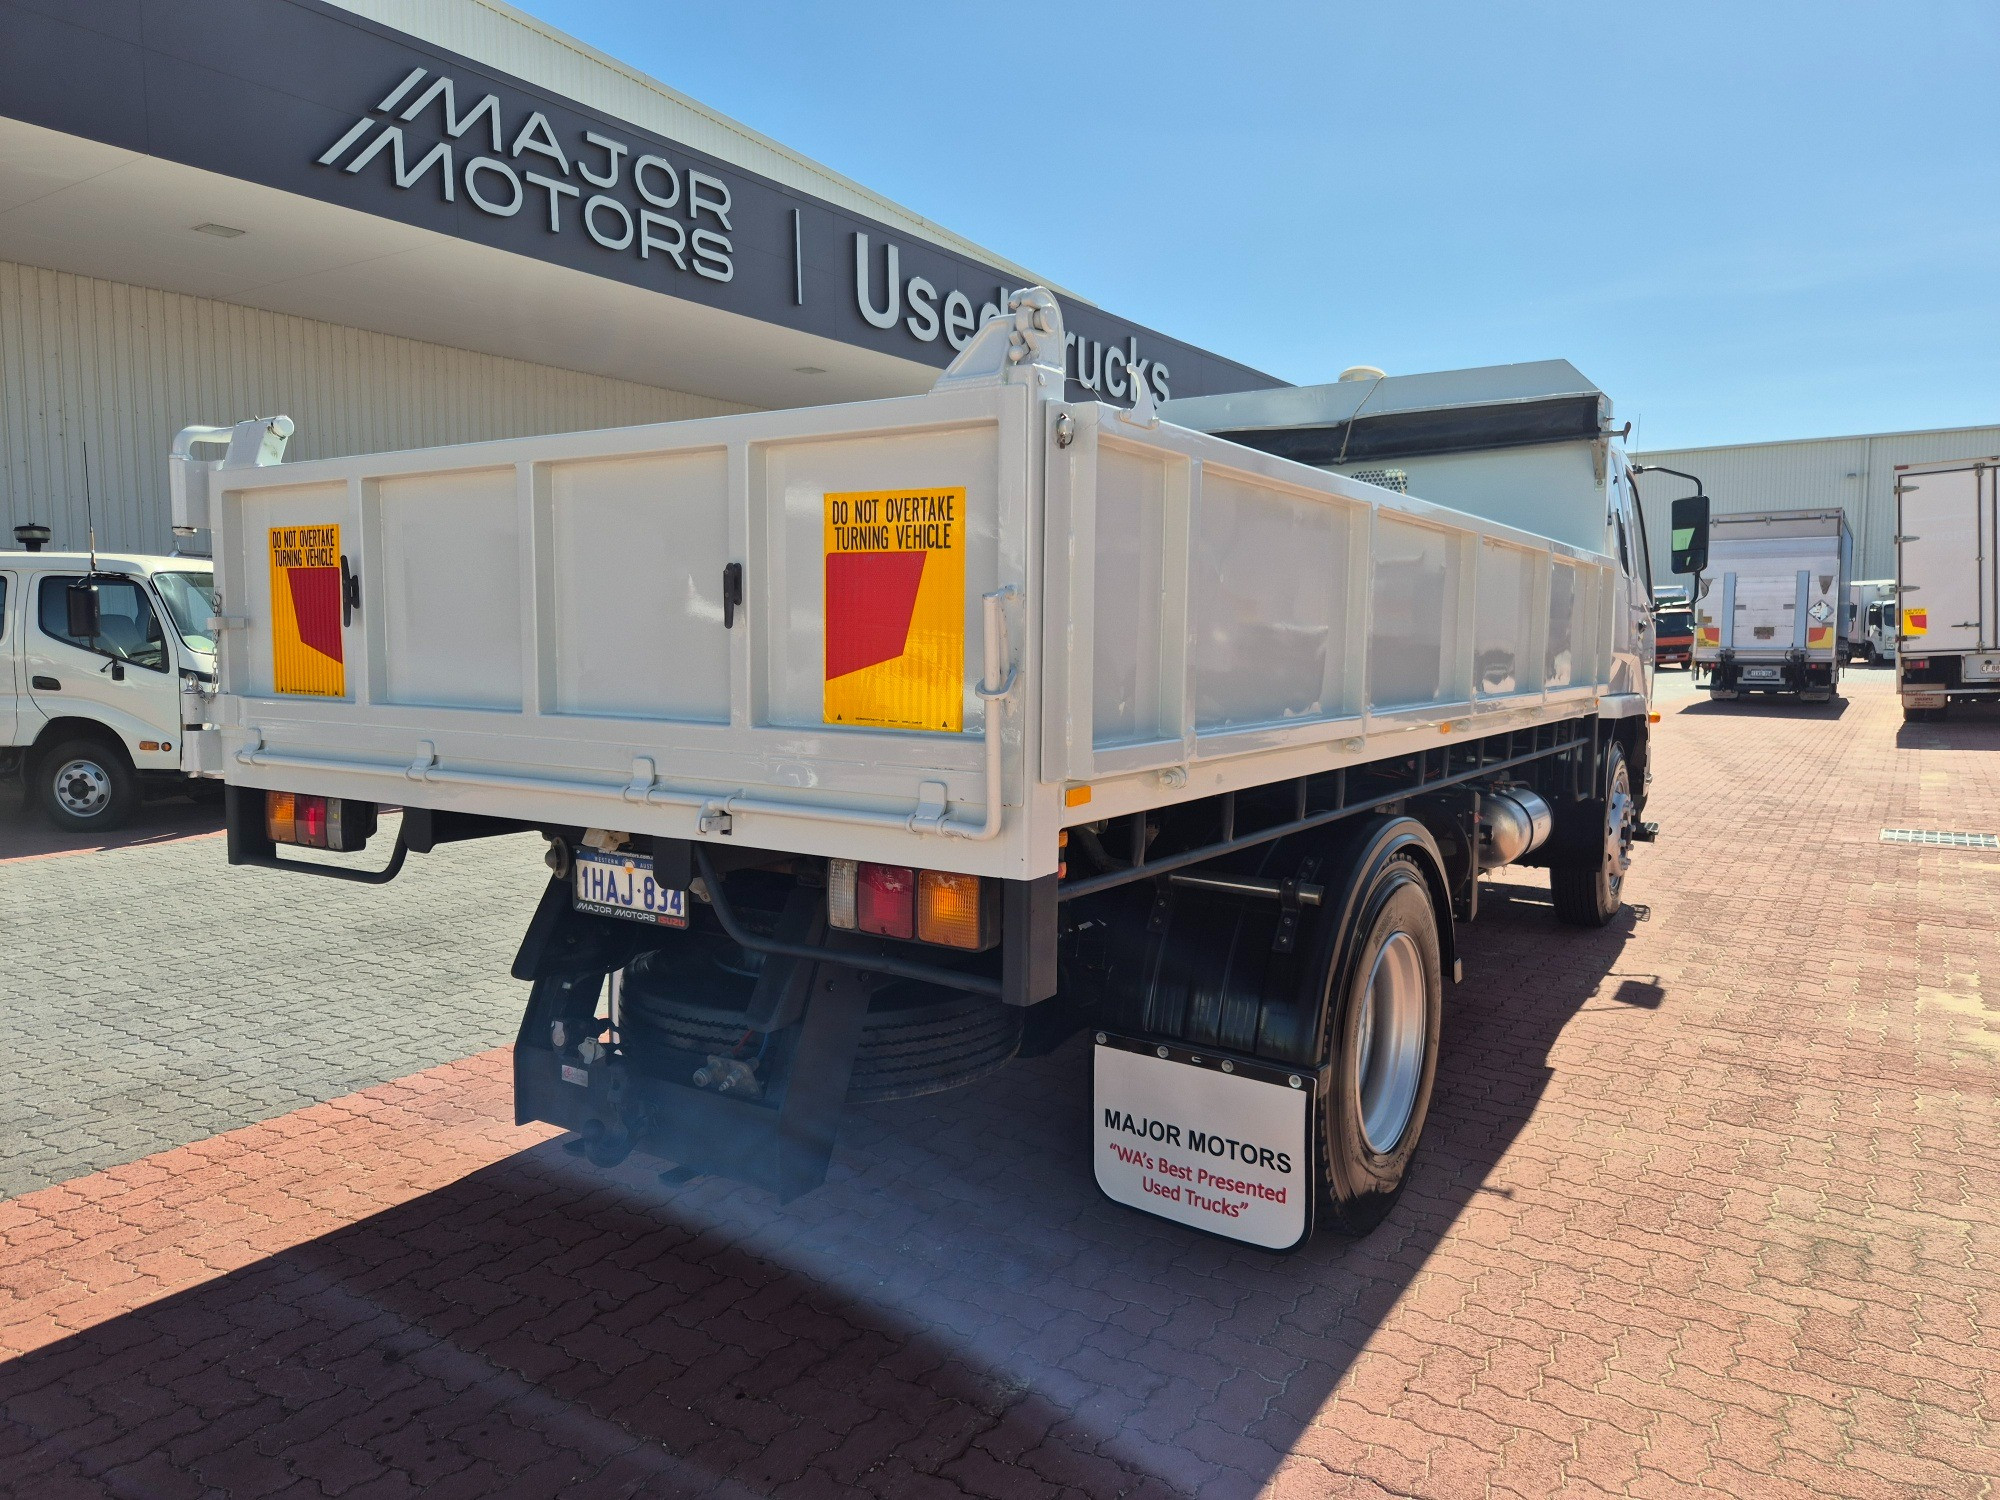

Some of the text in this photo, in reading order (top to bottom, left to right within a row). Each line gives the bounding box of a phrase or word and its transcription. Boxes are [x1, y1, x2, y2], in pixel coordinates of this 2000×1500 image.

[370, 67, 733, 232] MAJOR
[316, 117, 735, 283] MOTORS
[1063, 330, 1171, 411] rucks
[832, 495, 955, 526] DO NOT OVERTAKE
[272, 529, 334, 548] DO NOT OVERTAKE
[835, 523, 952, 551] TURNING VEHICLE
[275, 548, 334, 567] TURNING VEHICLE
[576, 902, 686, 928] MAJOR MOTORS ISUZU
[1104, 1108, 1292, 1174] MAJOR MOTORS
[1142, 1175, 1181, 1202] Used
[1158, 1157, 1193, 1182] Best
[1197, 1168, 1287, 1205] Presented
